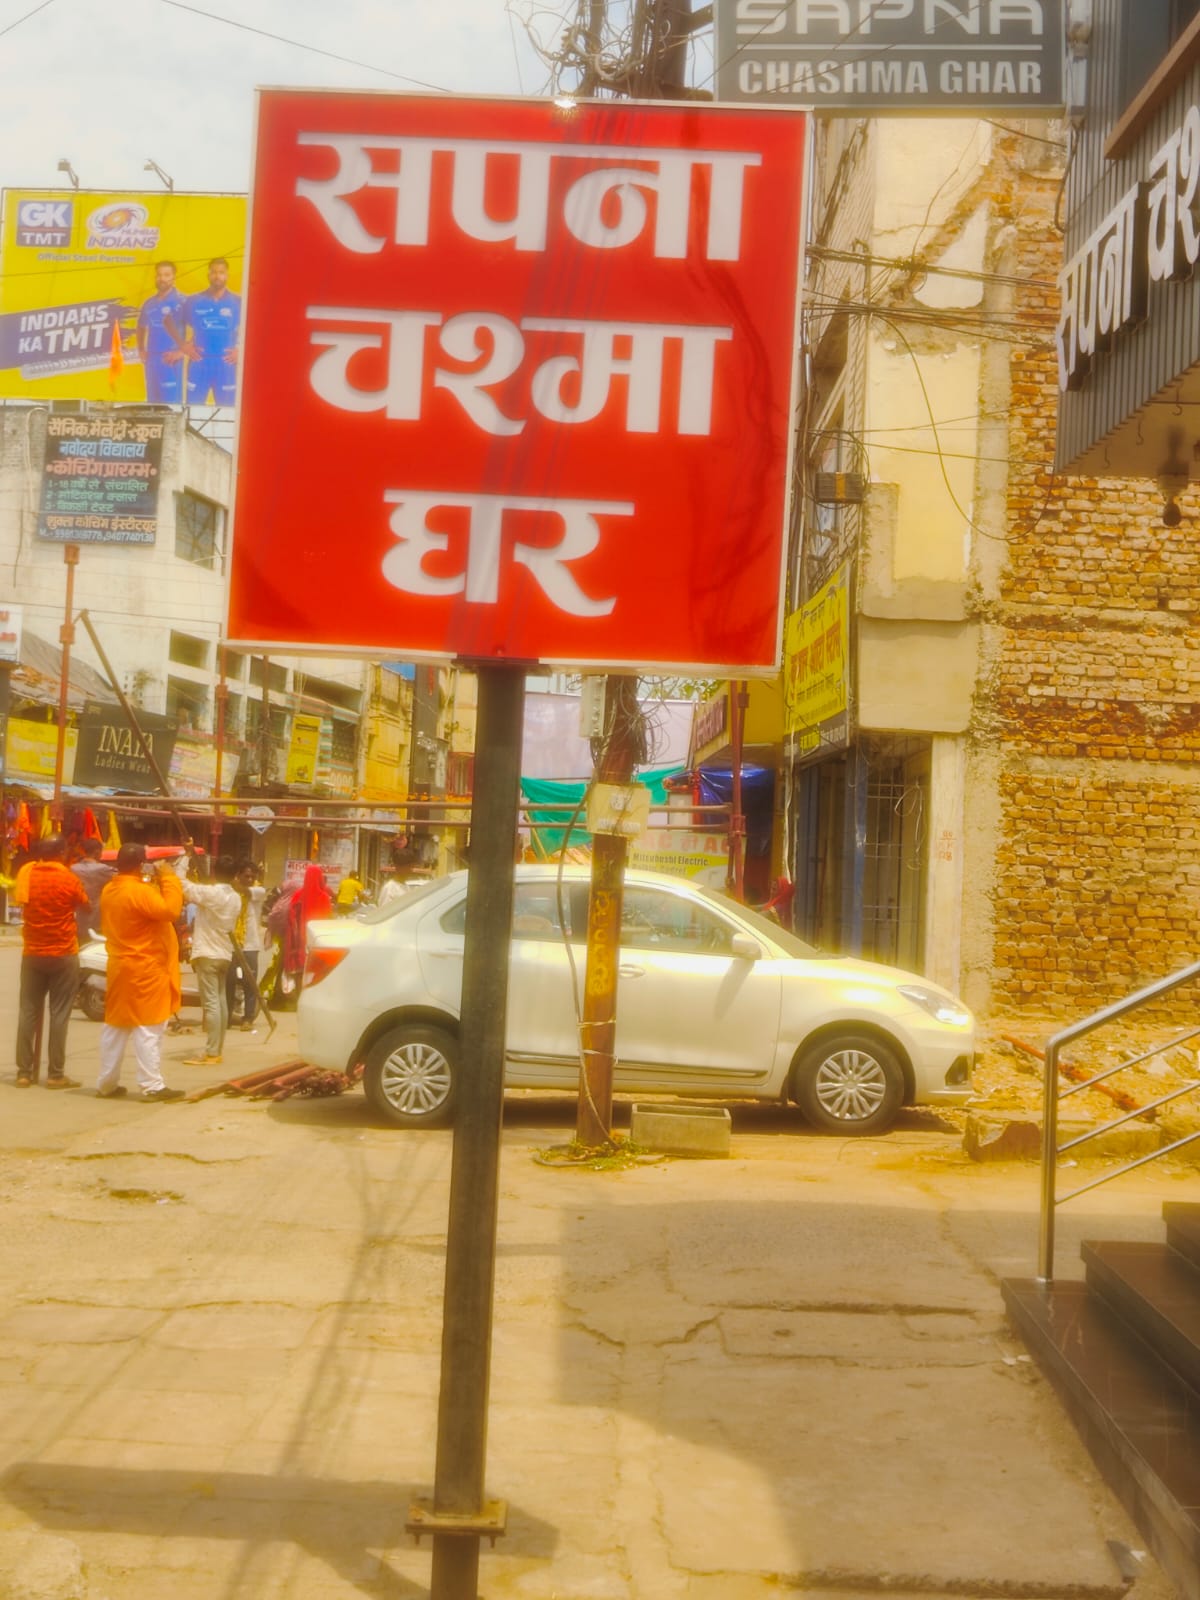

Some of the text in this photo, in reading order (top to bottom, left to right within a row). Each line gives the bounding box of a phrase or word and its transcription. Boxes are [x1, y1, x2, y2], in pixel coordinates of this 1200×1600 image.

[735, 0, 1044, 36] SAPNA
[738, 60, 1043, 95] CHASHMA GHAR
[295, 130, 763, 262] सपना
[20, 203, 68, 228] GK
[21, 232, 66, 246] TMT
[87, 235, 157, 249] INDIANS
[1056, 182, 1141, 393] सपना
[20, 305, 108, 333] INDIANS
[18, 323, 109, 354] KA TMT
[306, 305, 734, 437] चश्मा
[59, 438, 147, 459] नवोदय विद्यालय
[381, 488, 635, 617] घर
